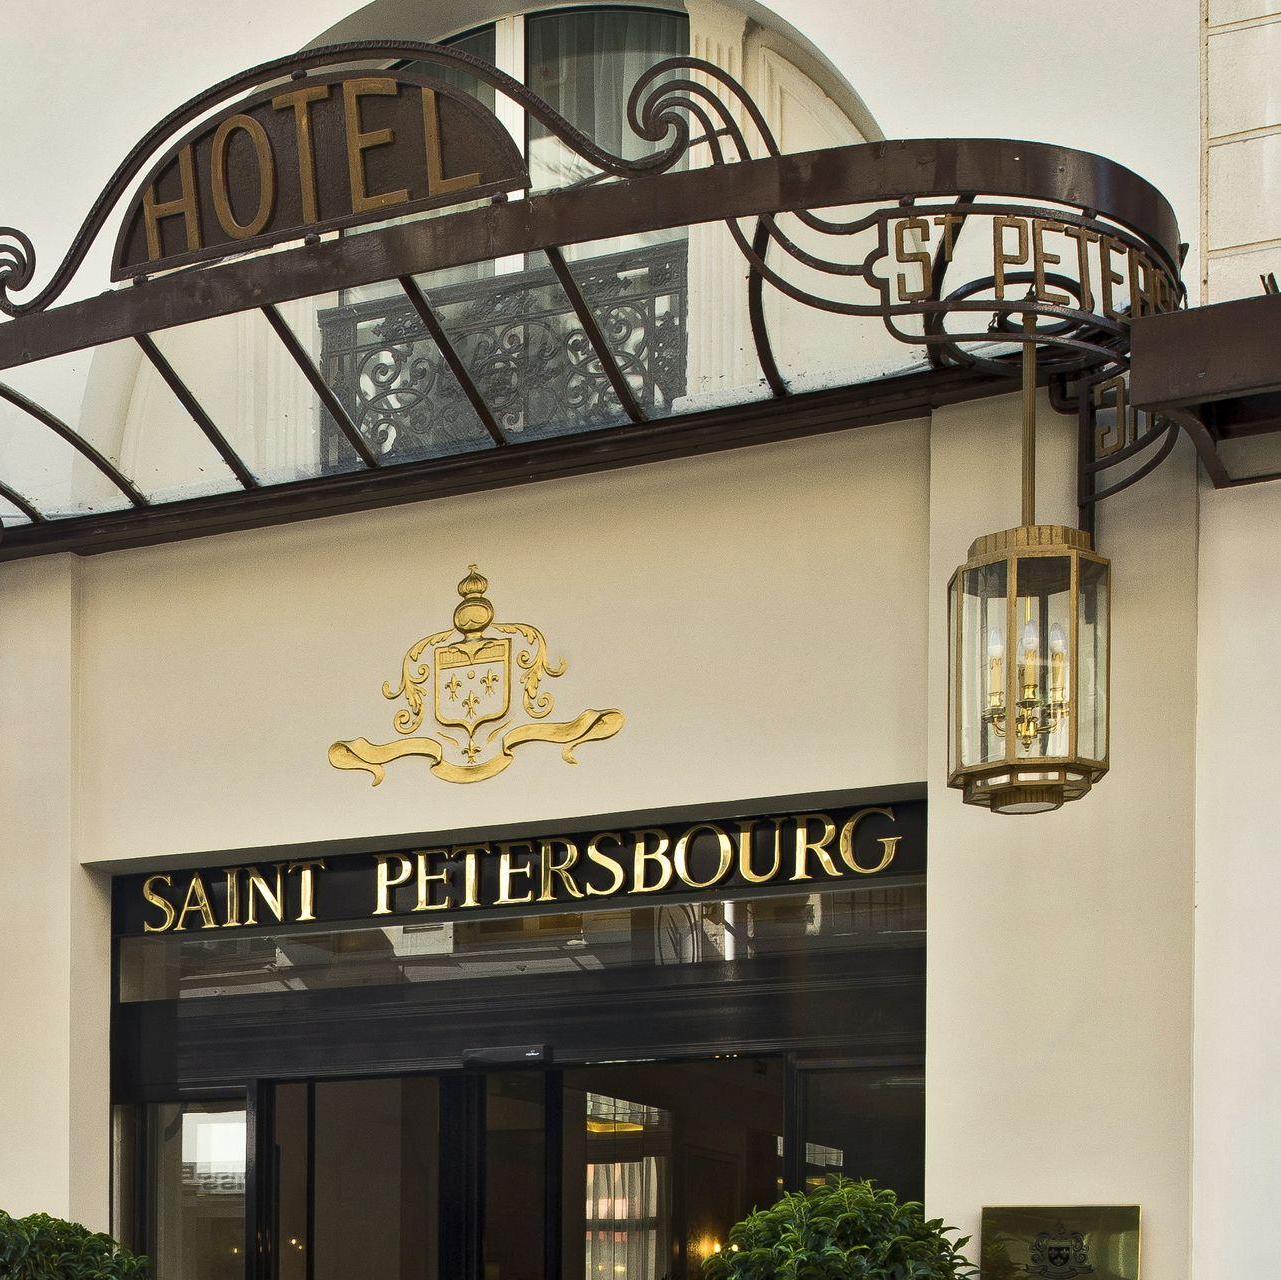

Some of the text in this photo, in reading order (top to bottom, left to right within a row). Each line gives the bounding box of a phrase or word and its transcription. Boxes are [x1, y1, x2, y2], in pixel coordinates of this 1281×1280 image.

[142, 77, 484, 261] HOTEL
[142, 806, 904, 933] SAINT PETERSBOURG
